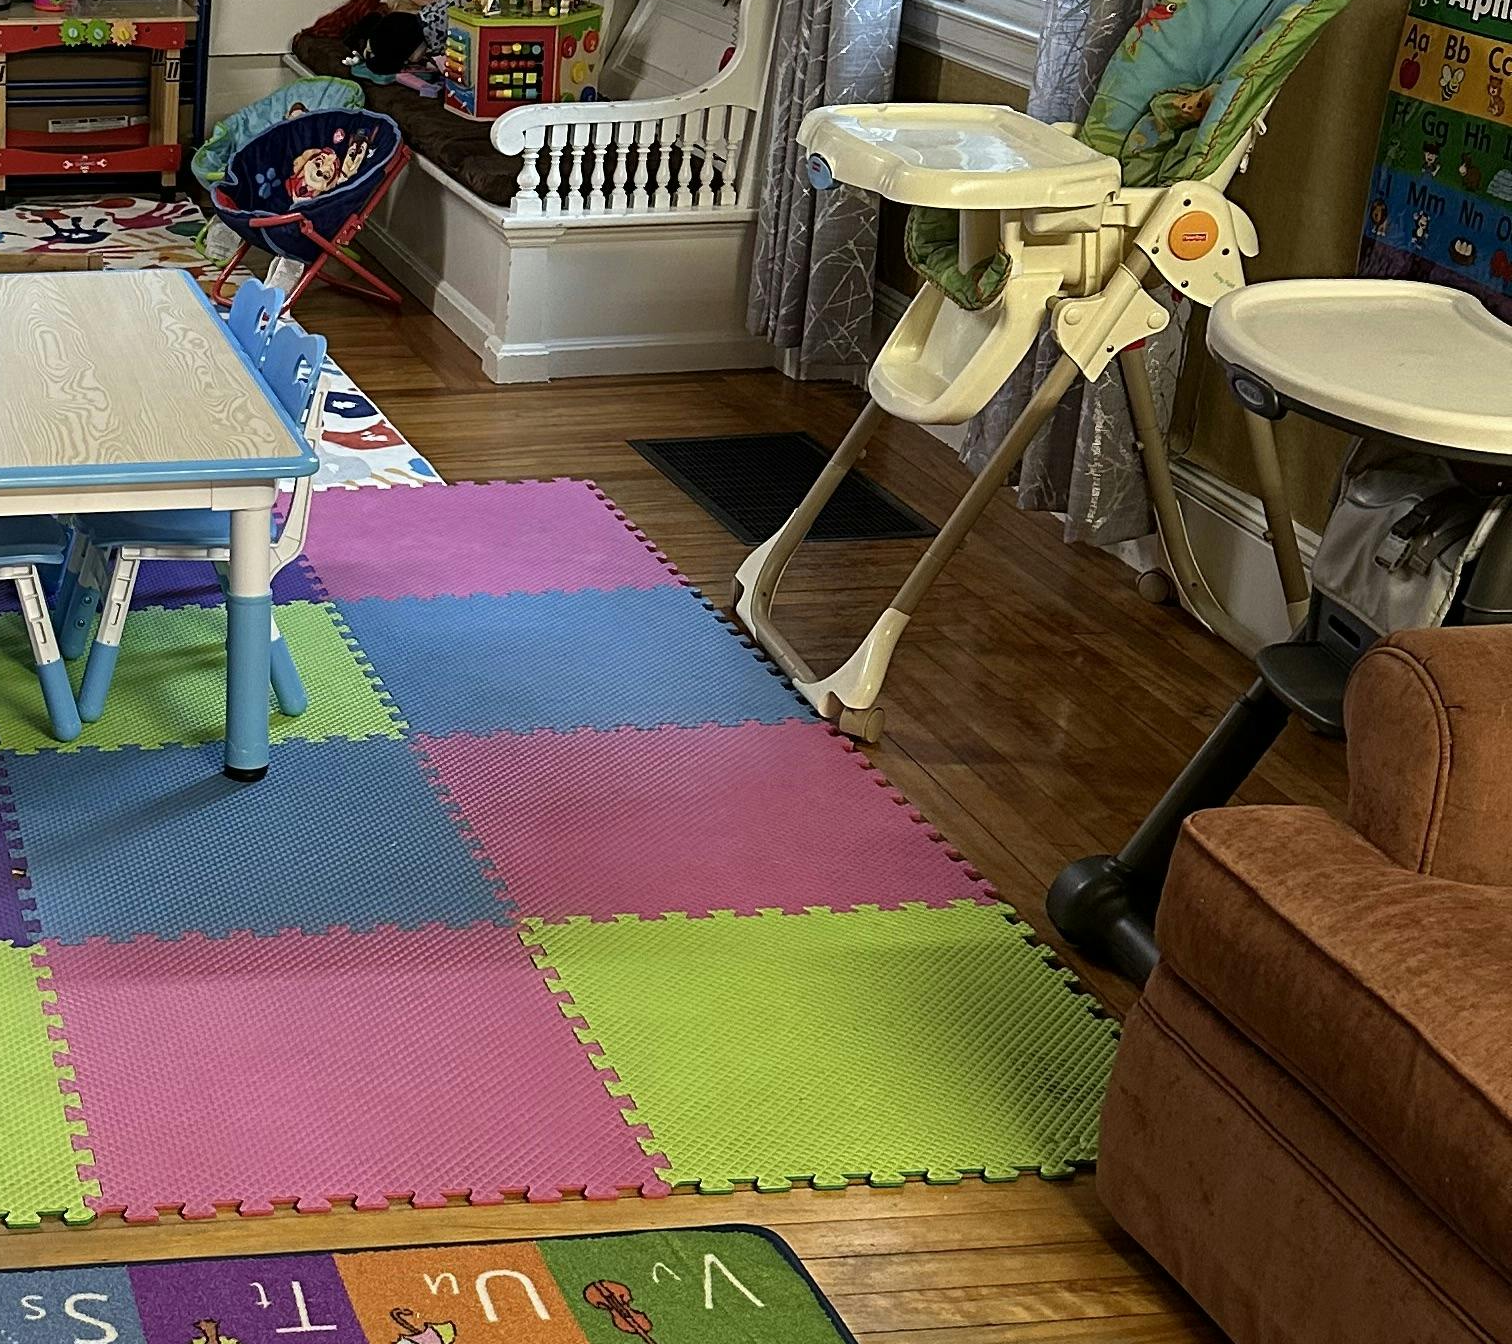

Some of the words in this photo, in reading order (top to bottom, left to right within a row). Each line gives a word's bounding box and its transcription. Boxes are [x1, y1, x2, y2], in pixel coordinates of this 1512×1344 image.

[1404, 24, 1431, 54] Aa
[1445, 34, 1471, 64] Bb
[1422, 111, 1449, 148] Gg
[1464, 122, 1491, 152] Hh
[1406, 182, 1445, 215] Mm
[1459, 200, 1484, 232] Nn
